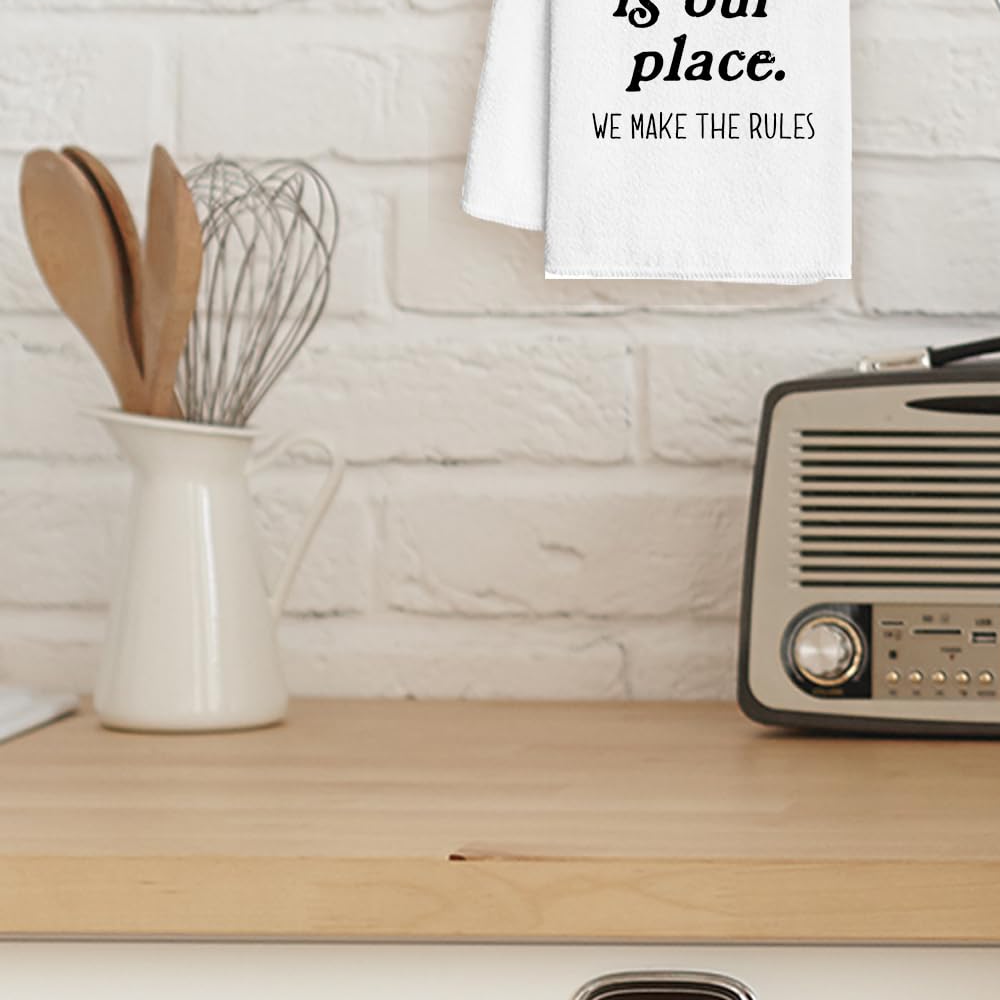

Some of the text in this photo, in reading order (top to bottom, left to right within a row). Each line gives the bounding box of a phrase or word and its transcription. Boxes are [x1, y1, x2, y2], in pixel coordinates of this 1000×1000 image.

[625, 33, 786, 93] place.
[591, 111, 815, 140] WE MAKE THE RULES
